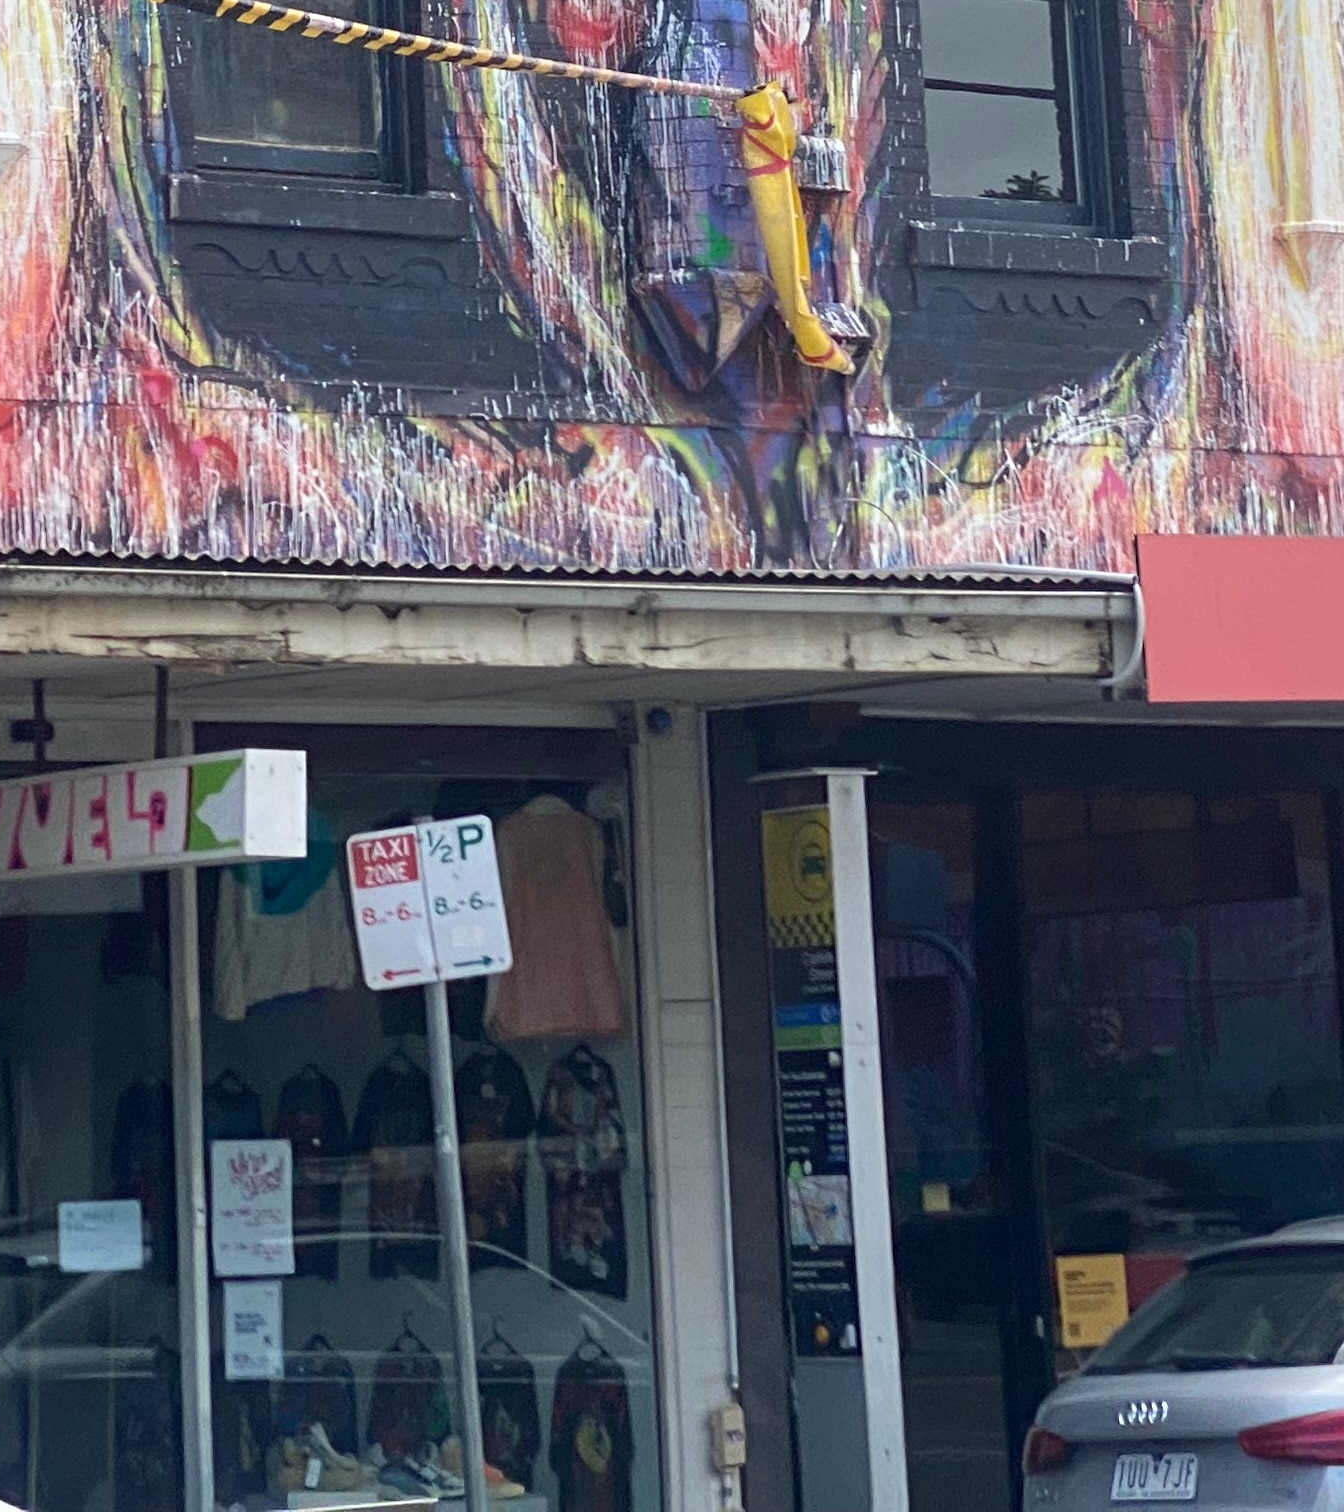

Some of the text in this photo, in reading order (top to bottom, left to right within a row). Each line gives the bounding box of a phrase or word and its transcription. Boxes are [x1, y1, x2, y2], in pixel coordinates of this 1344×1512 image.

[359, 836, 410, 864] TAXI
[364, 861, 410, 886] ZONE
[1163, 1457, 1196, 1488] 7JF
